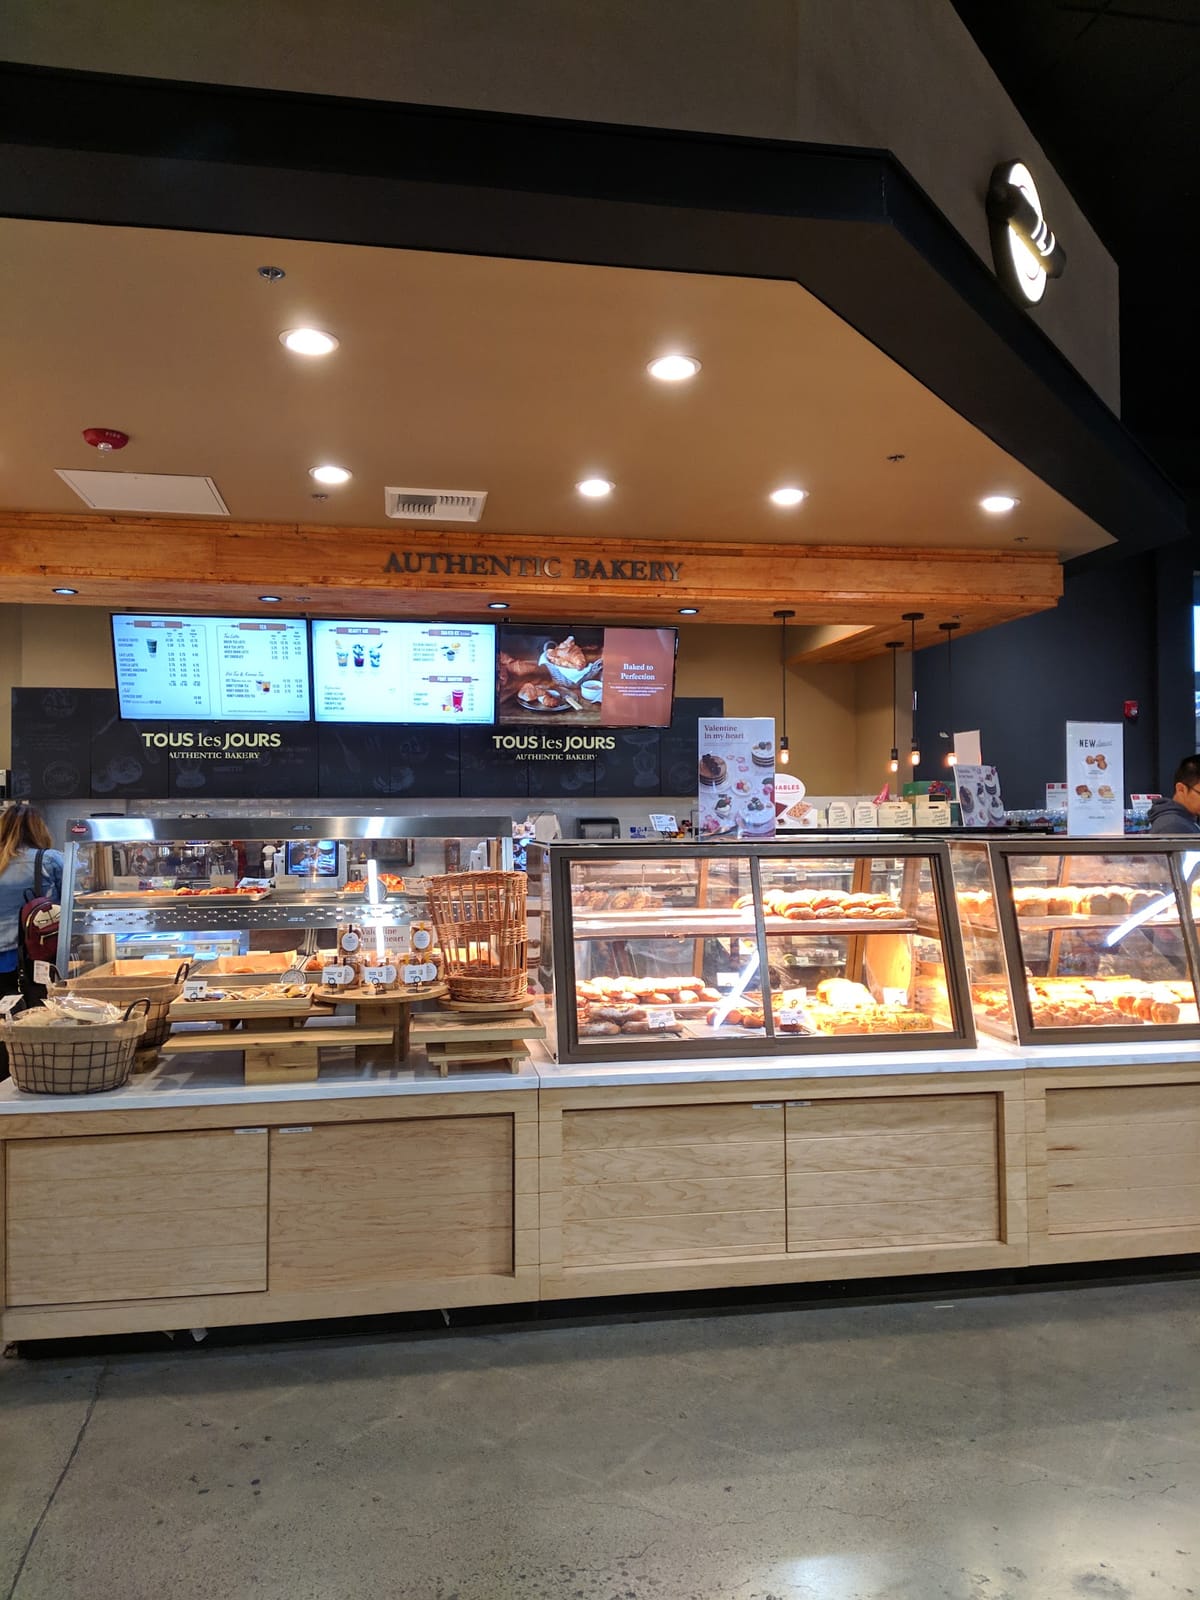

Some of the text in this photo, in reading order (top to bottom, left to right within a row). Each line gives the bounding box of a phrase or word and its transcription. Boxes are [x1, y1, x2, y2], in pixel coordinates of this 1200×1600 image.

[383, 551, 684, 583] AUTHENTIC BAKERY
[623, 663, 645, 671] Baked
[620, 672, 656, 681] Perfection
[704, 724, 738, 732] Valentine
[142, 732, 282, 751] TOUS les JOURS
[713, 733, 723, 741] my
[492, 735, 616, 752] TOUS les JOURS
[1079, 739, 1097, 748] NEW
[169, 751, 260, 760] AUTHENTIC BAKERY
[515, 753, 564, 761] AUTHENTIC
